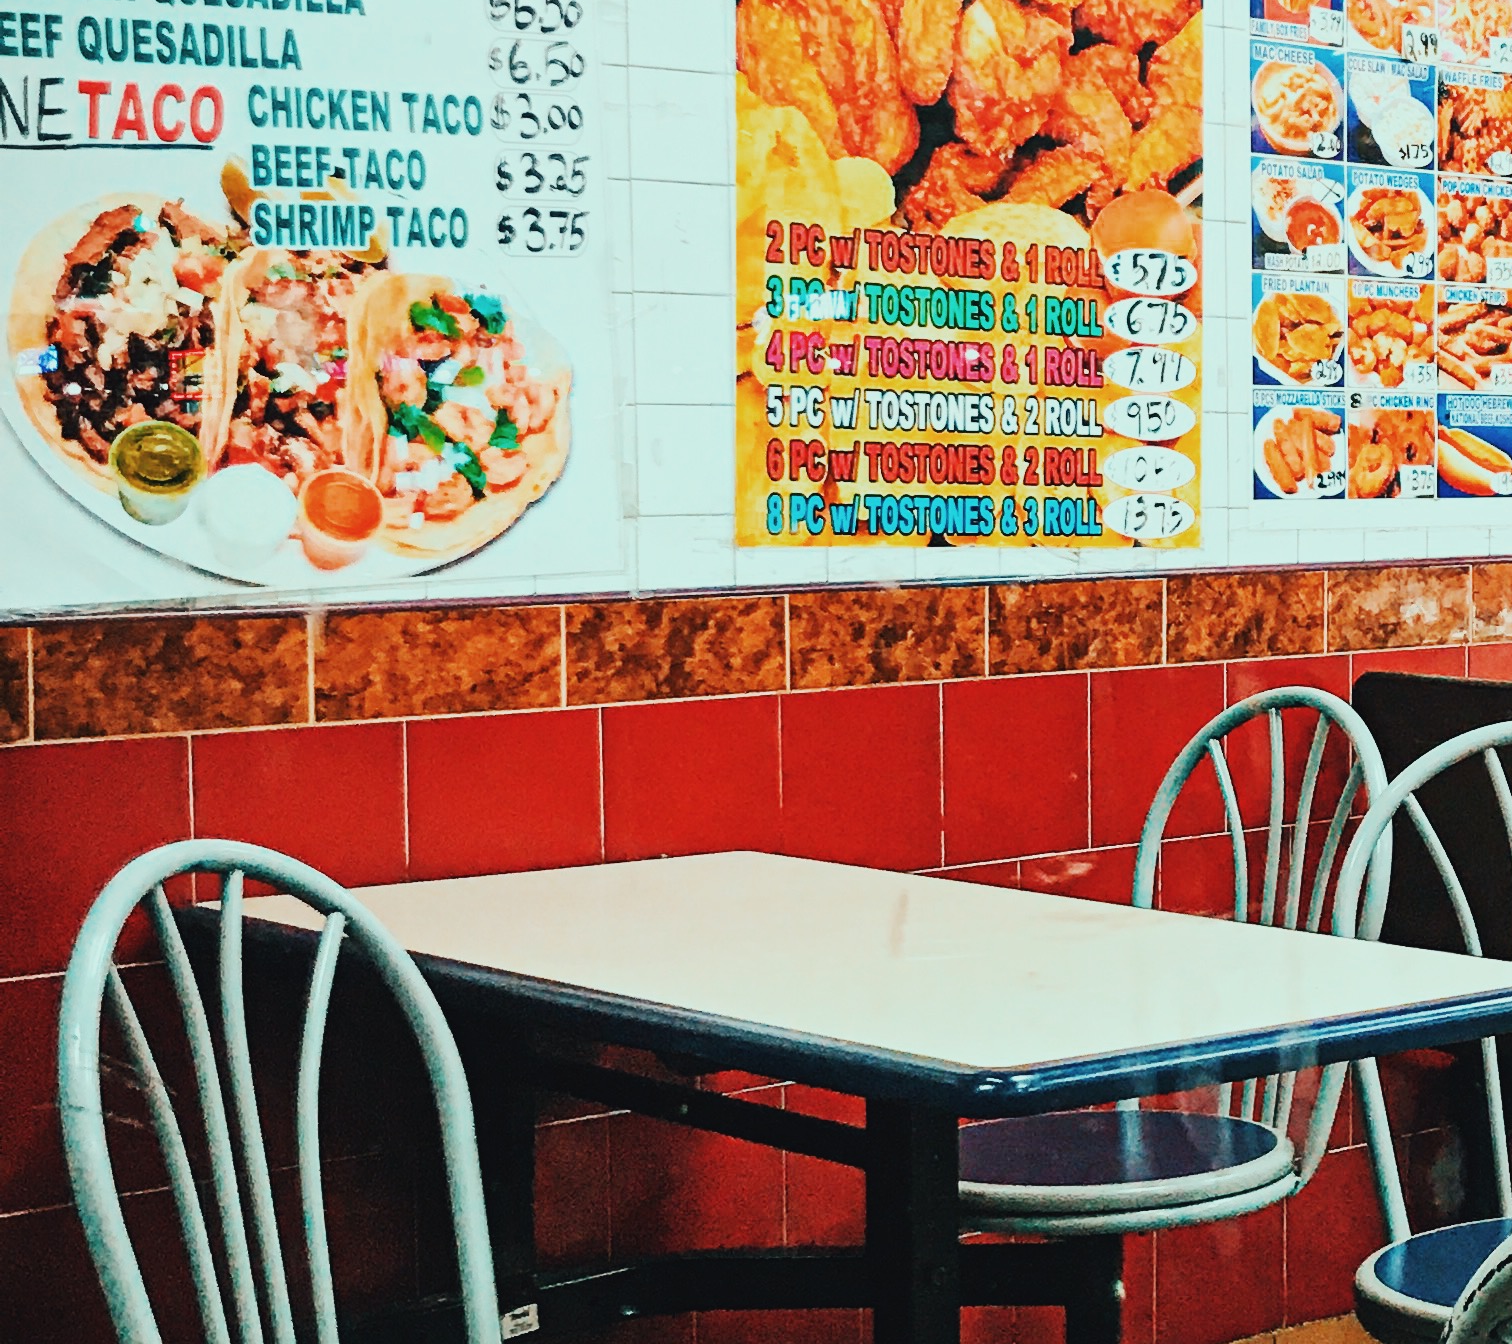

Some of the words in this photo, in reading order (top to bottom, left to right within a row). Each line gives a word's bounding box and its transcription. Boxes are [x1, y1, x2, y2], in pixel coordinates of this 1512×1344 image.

[0, 13, 63, 60] EEF
[78, 15, 302, 71] QUESADILLA
[1255, 45, 1274, 60] MAC
[1278, 49, 1313, 65] CHEESE
[1444, 71, 1477, 87] WAFFLE
[1479, 75, 1502, 90] FRIES
[78, 79, 224, 143] TACO
[248, 84, 390, 132] CHICKEN
[402, 92, 483, 137] TACO
[252, 144, 332, 190] BEEF
[348, 148, 426, 191] TACO
[1261, 163, 1295, 178] POTATO
[1297, 166, 1324, 181] SALAD
[1353, 170, 1386, 186] POTATO
[1387, 174, 1418, 189] WEDGES
[1443, 180, 1457, 193] POP
[1460, 183, 1480, 195] CORN
[253, 201, 376, 247] SHRIMP
[387, 206, 469, 249] TACO
[765, 220, 785, 264] 2
[789, 224, 825, 268] PC
[830, 228, 861, 271] w/
[865, 230, 995, 279] TOSTONES
[1001, 243, 1019, 279] &
[1025, 245, 1039, 281] 1
[1045, 247, 1105, 286] ROLL
[1263, 277, 1288, 291] FRIED
[1289, 279, 1330, 294] PLANTAIN
[1376, 285, 1419, 298] MUNCHERS
[1445, 289, 1478, 301] CHICKEN
[1480, 291, 1506, 304] STRIPS
[765, 386, 785, 428] 5
[789, 386, 825, 430] PC
[830, 388, 861, 430] w/
[865, 389, 995, 435] TOSTONES
[1001, 396, 1019, 435] &
[1023, 395, 1039, 435] 2
[1045, 395, 1105, 437] ROLL
[765, 493, 785, 535] 8
[789, 493, 825, 536] PC
[830, 493, 861, 536] w/
[865, 494, 995, 536] TOSTONES
[1001, 497, 1019, 536] &
[1023, 495, 1039, 536] 3
[1045, 495, 1105, 536] ROLL
